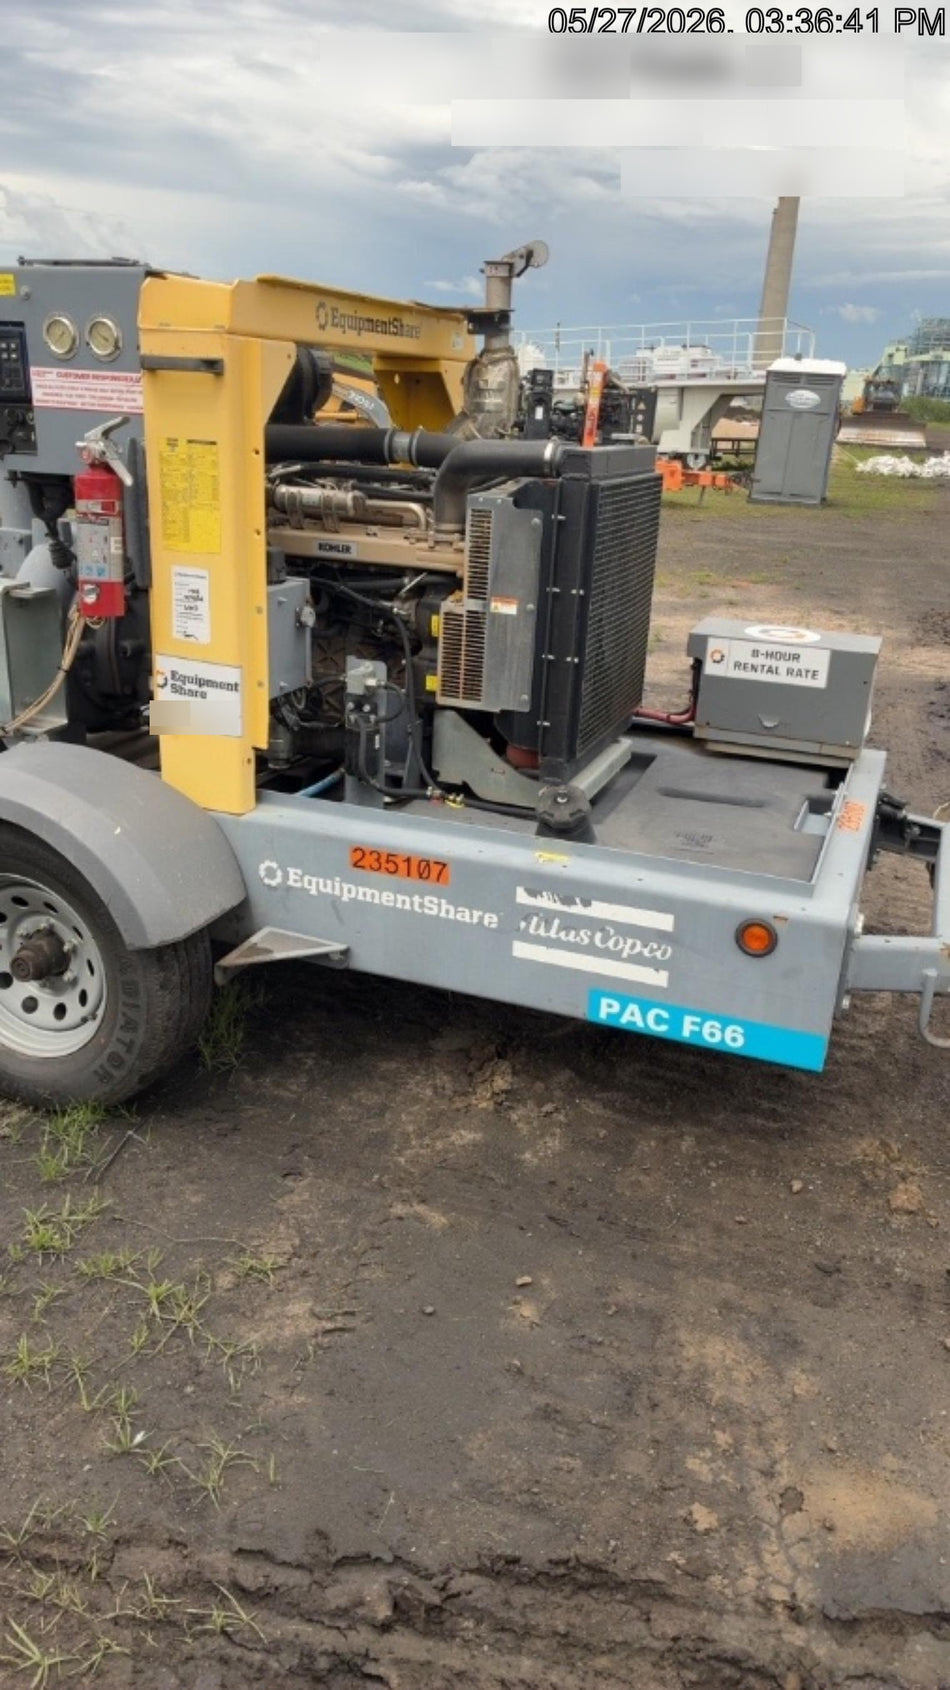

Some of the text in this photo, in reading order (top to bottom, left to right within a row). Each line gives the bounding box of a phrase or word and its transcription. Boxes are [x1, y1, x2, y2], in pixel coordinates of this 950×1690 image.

[331, 306, 421, 339] EquipmentShare
[318, 542, 352, 554] KOHLER
[751, 648, 801, 663] 8-HOUR
[170, 670, 240, 692] Equipment
[733, 660, 820, 680] RENTAL RATE
[170, 683, 207, 699] Share
[352, 847, 448, 883] 235107
[286, 867, 499, 929] EquipmentShare
[594, 925, 673, 961] Copco
[598, 997, 746, 1048] PAC F66
